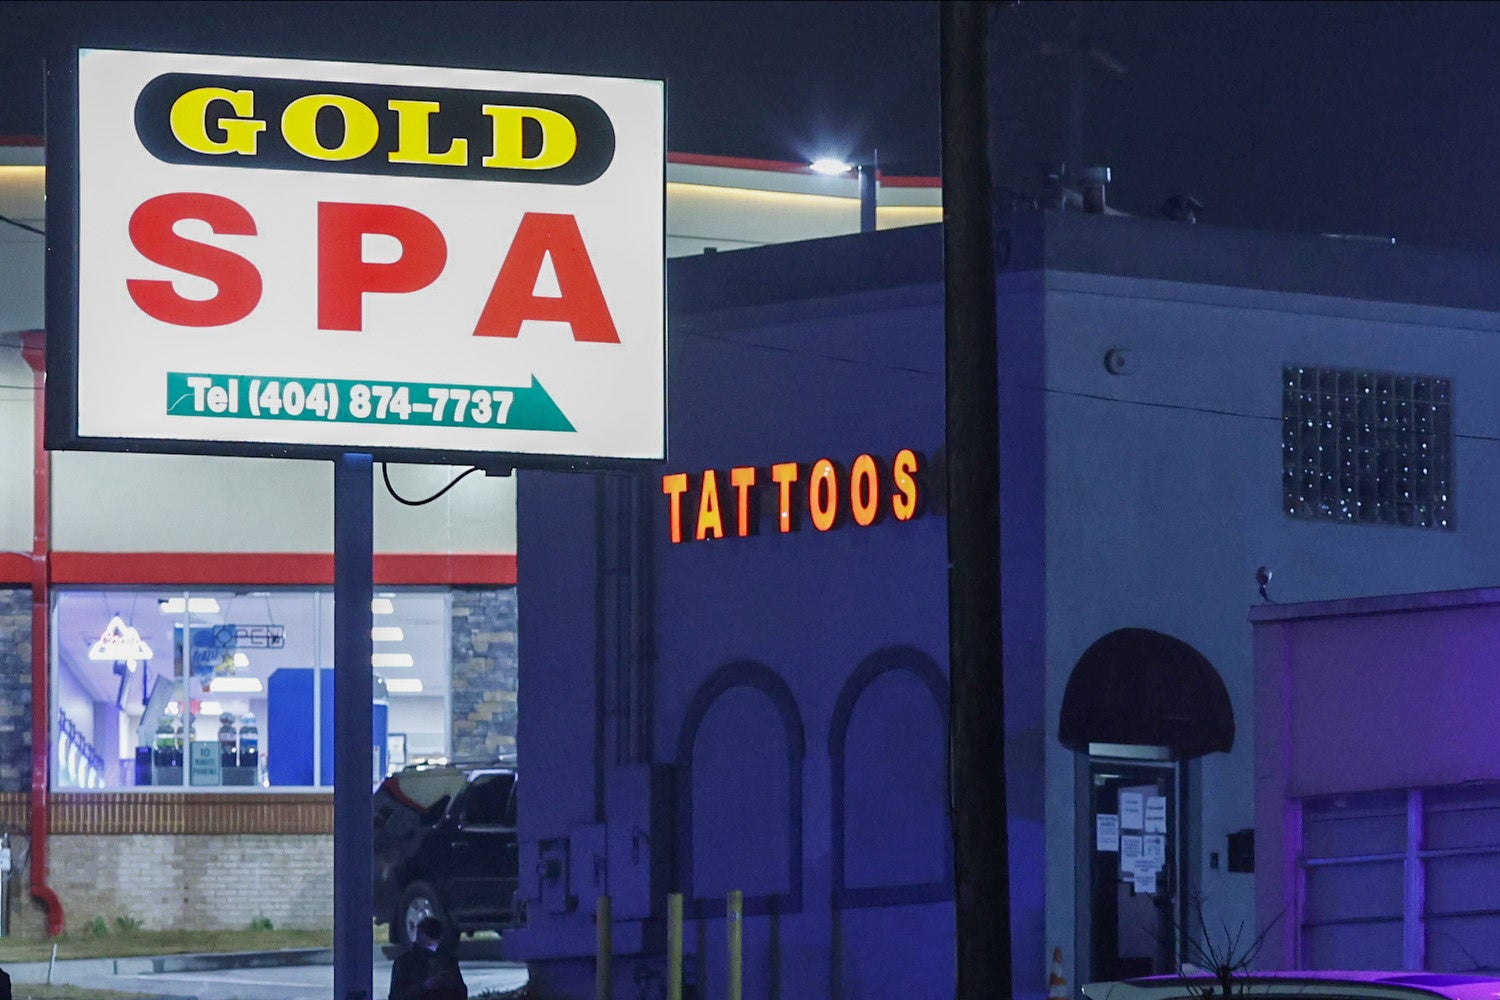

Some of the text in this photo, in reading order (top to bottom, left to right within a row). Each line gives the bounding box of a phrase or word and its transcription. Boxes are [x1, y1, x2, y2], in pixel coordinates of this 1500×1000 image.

[169, 87, 578, 171] GOLD
[126, 192, 621, 344] SPA
[188, 377, 514, 424] Tel (404) 874-7737
[662, 448, 918, 544] TATTOOS
